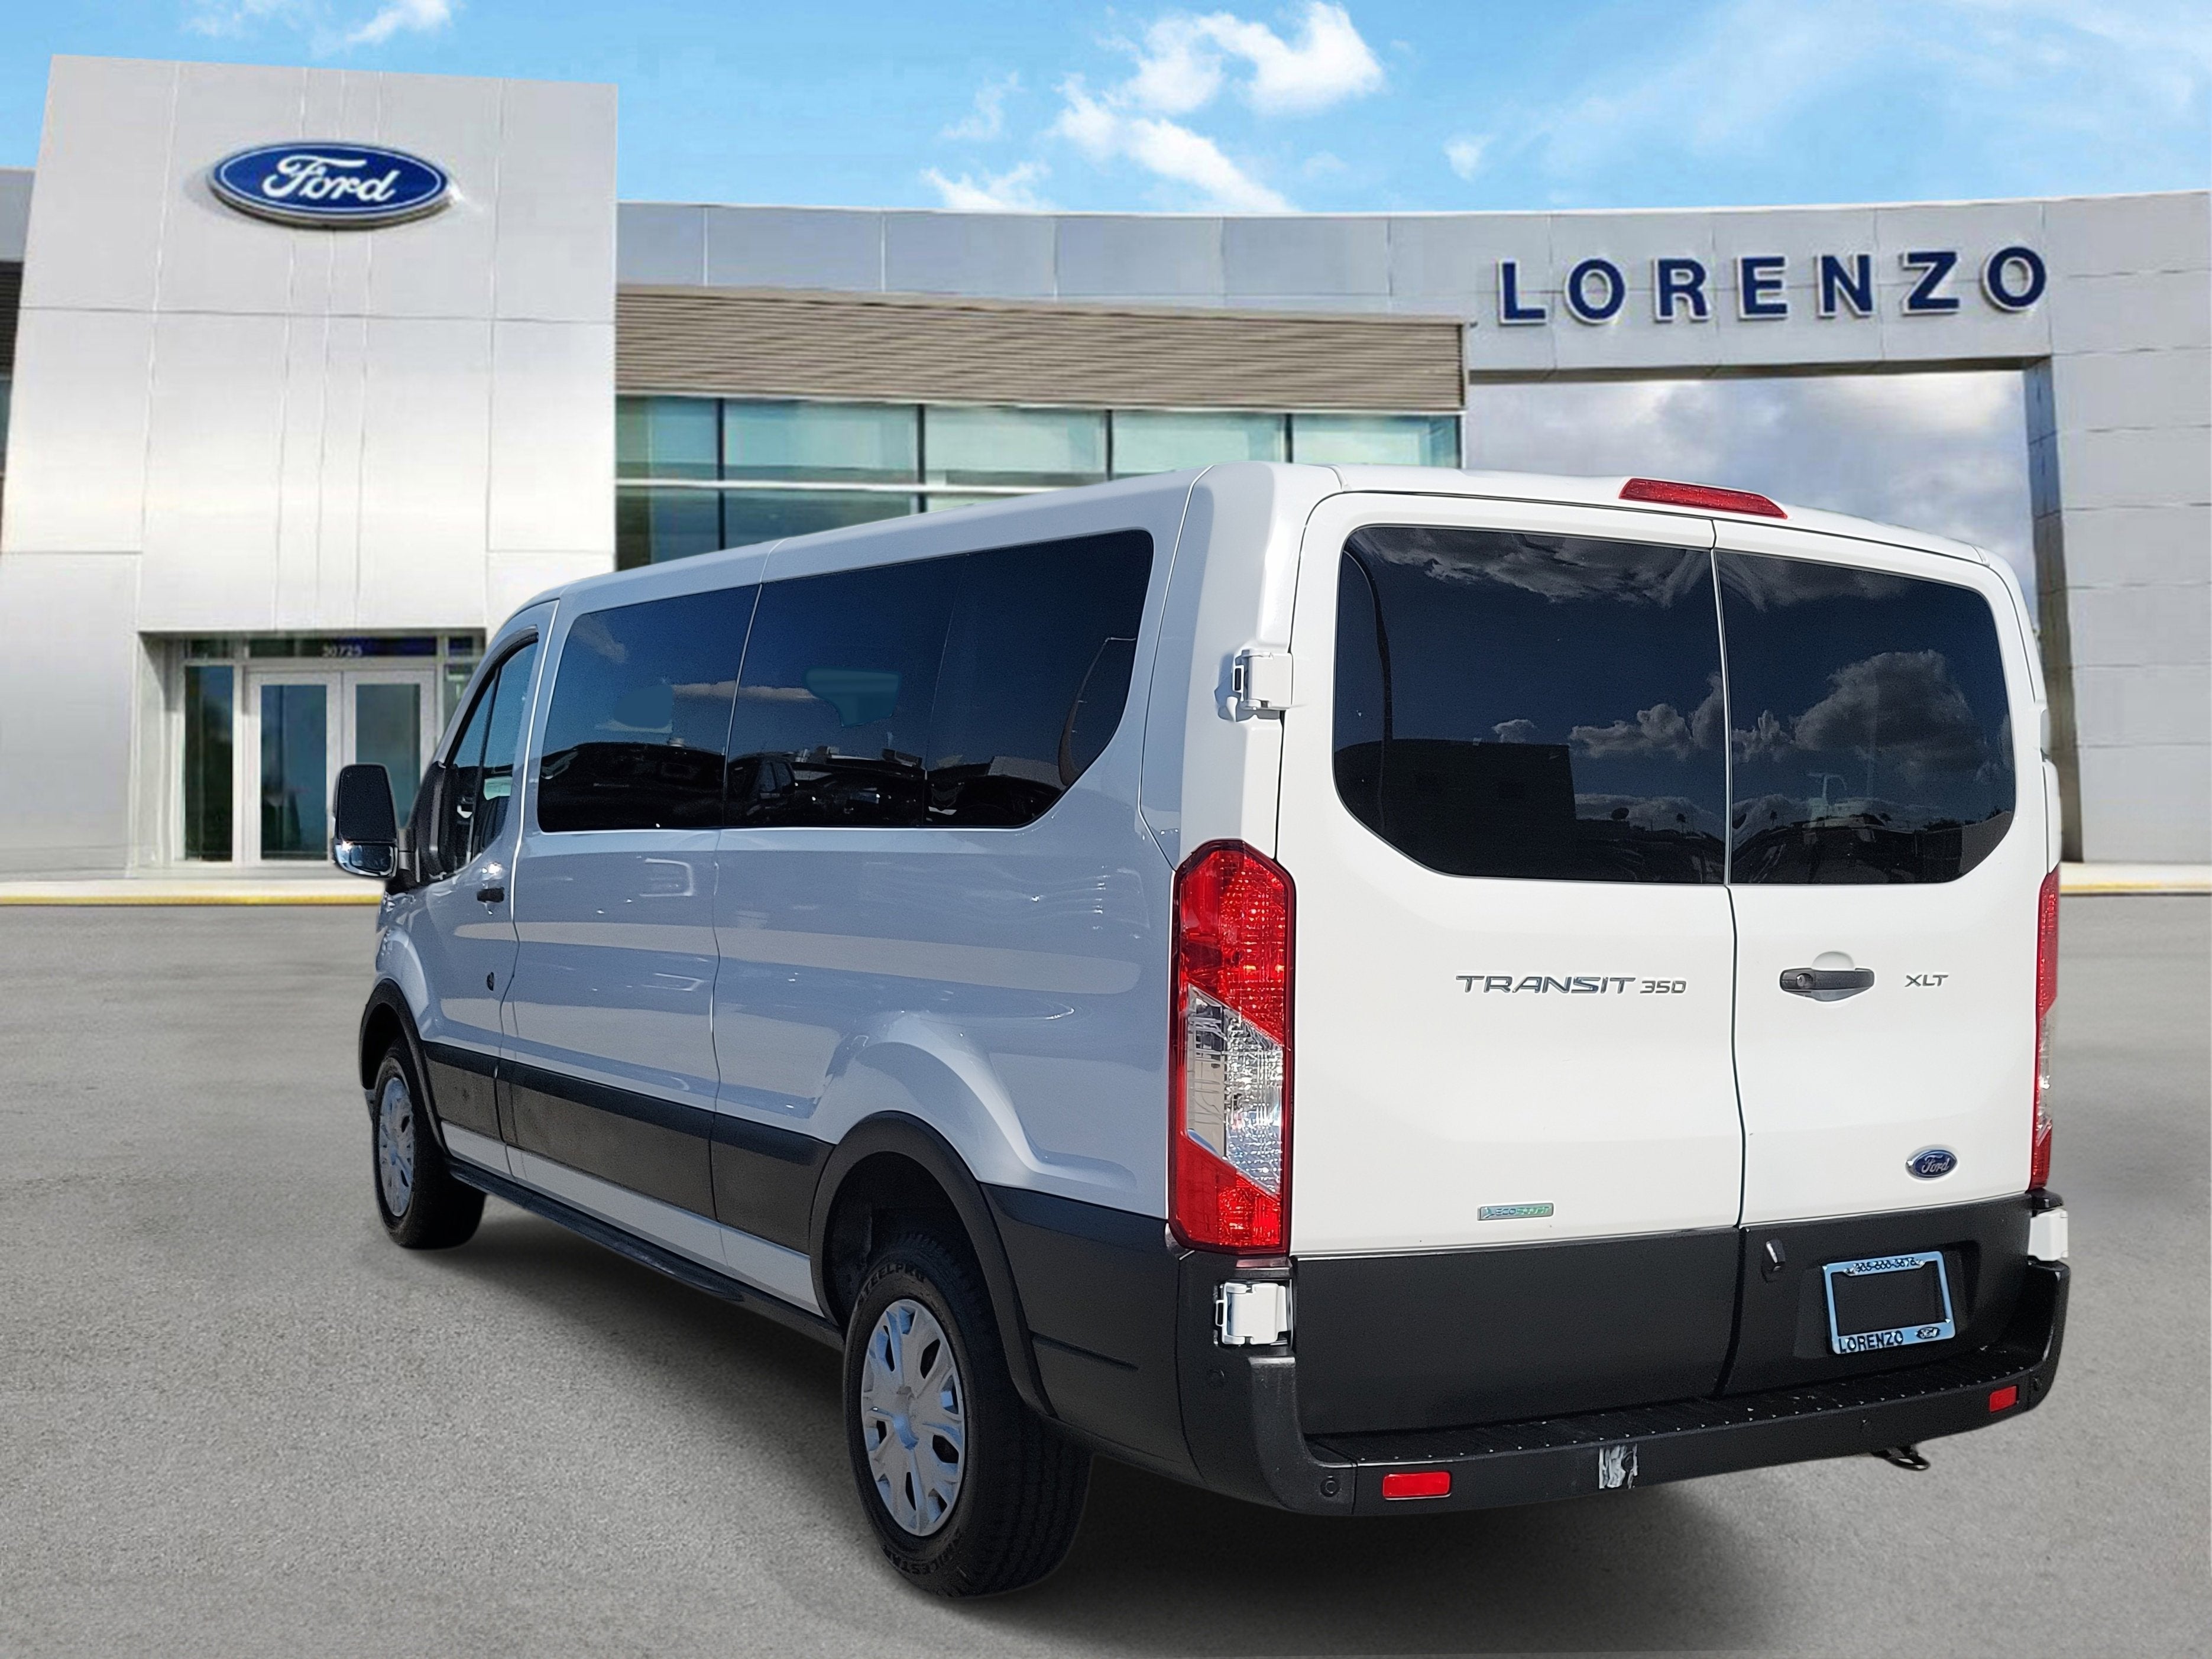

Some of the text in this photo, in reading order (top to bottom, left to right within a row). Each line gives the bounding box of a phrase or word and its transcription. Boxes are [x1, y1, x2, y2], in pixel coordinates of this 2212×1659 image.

[262, 154, 401, 202] Ford
[1498, 245, 2047, 326] LORENZO
[1456, 976, 1687, 994] TRANSIT 350
[1904, 974, 1949, 987] XLT
[1921, 1154, 1951, 1174] Ford
[1838, 1330, 1904, 1353] LORENZO
